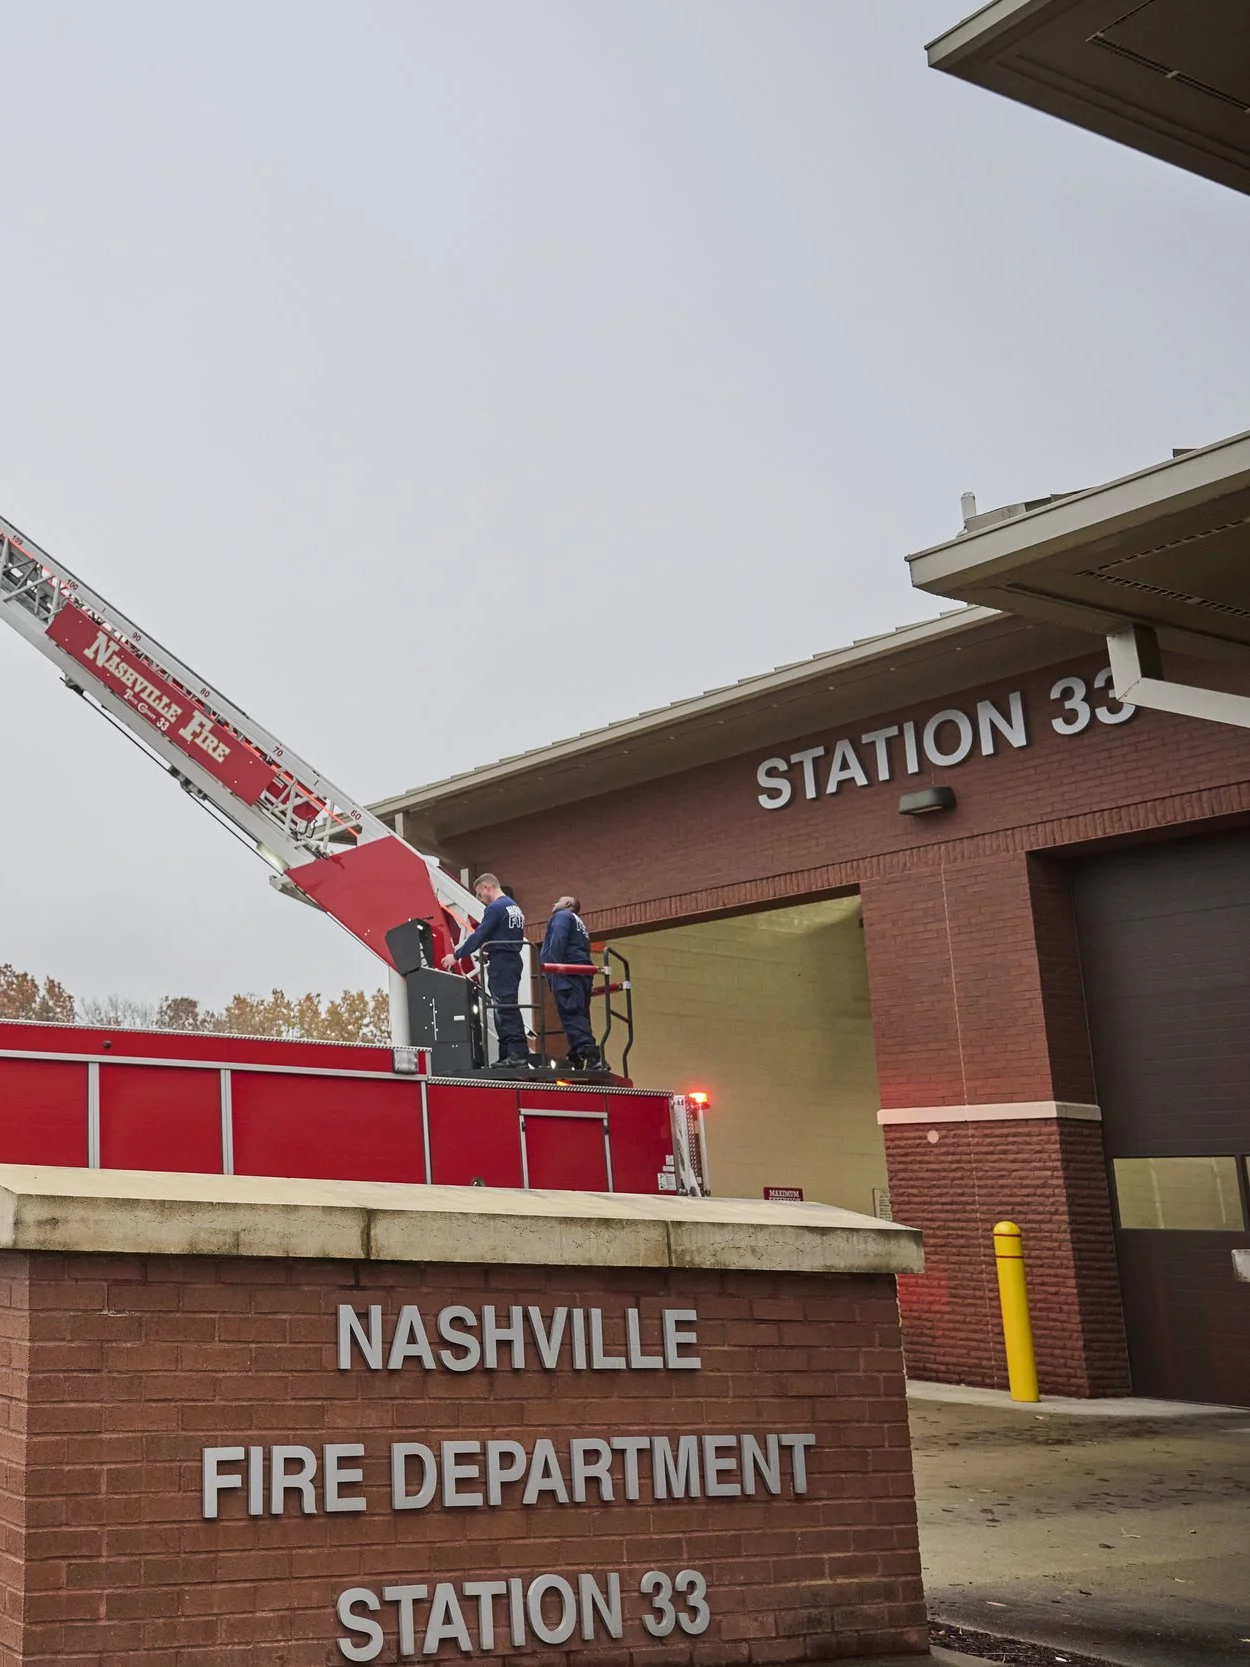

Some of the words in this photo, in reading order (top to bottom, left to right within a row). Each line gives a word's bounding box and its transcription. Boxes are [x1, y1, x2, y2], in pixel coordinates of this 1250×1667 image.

[66, 579, 79, 591] 100
[131, 632, 142, 642] 90
[200, 687, 211, 698] 80
[156, 717, 170, 731] 33
[756, 692, 1028, 810] STATION
[1050, 667, 1137, 736] 33
[272, 746, 284, 758] 70
[350, 809, 362, 821] 60
[336, 1304, 702, 1372] NASHVILLE
[202, 1443, 367, 1519] FIRE
[391, 1433, 816, 1510] DEPARTMENT
[336, 1571, 623, 1662] STATION
[639, 1569, 711, 1637] 33
